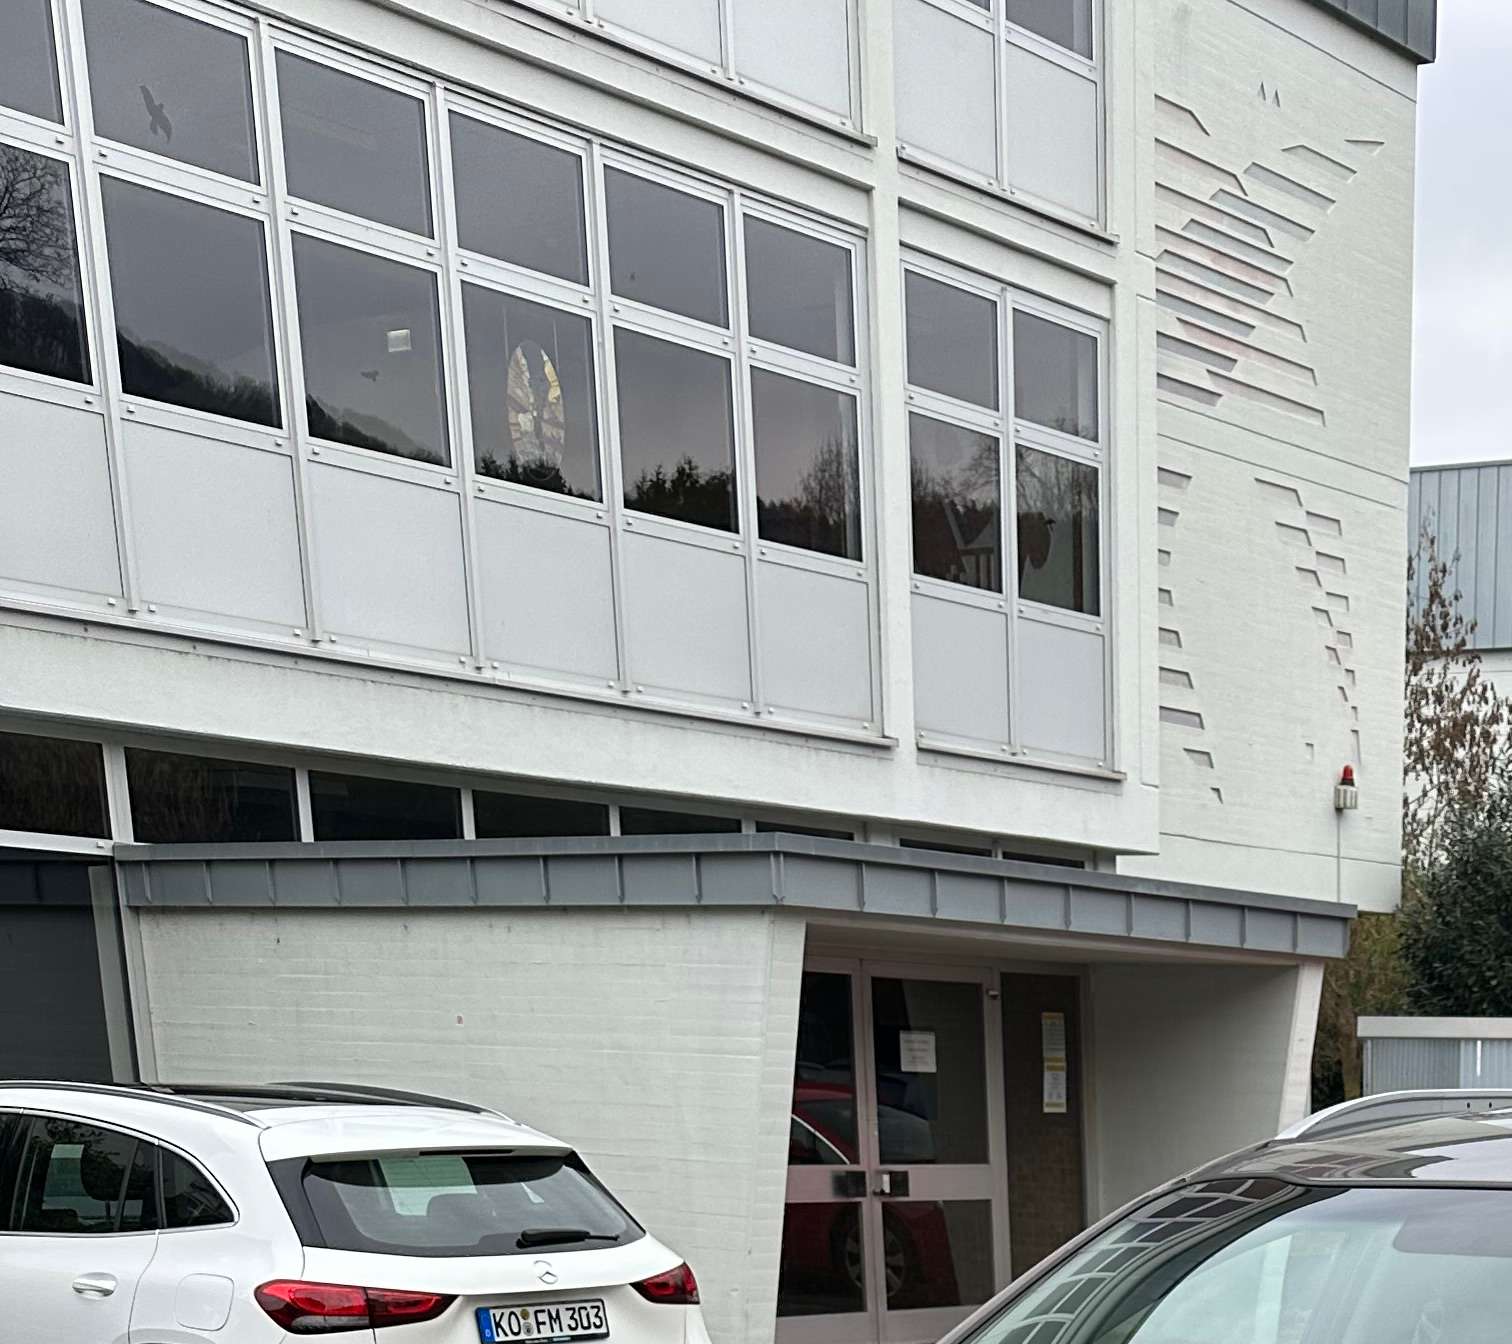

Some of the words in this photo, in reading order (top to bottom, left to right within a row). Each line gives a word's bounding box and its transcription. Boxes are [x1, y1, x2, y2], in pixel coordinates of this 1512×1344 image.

[492, 1311, 522, 1338] KO
[534, 1308, 564, 1334] FM
[565, 1305, 604, 1332] 303
